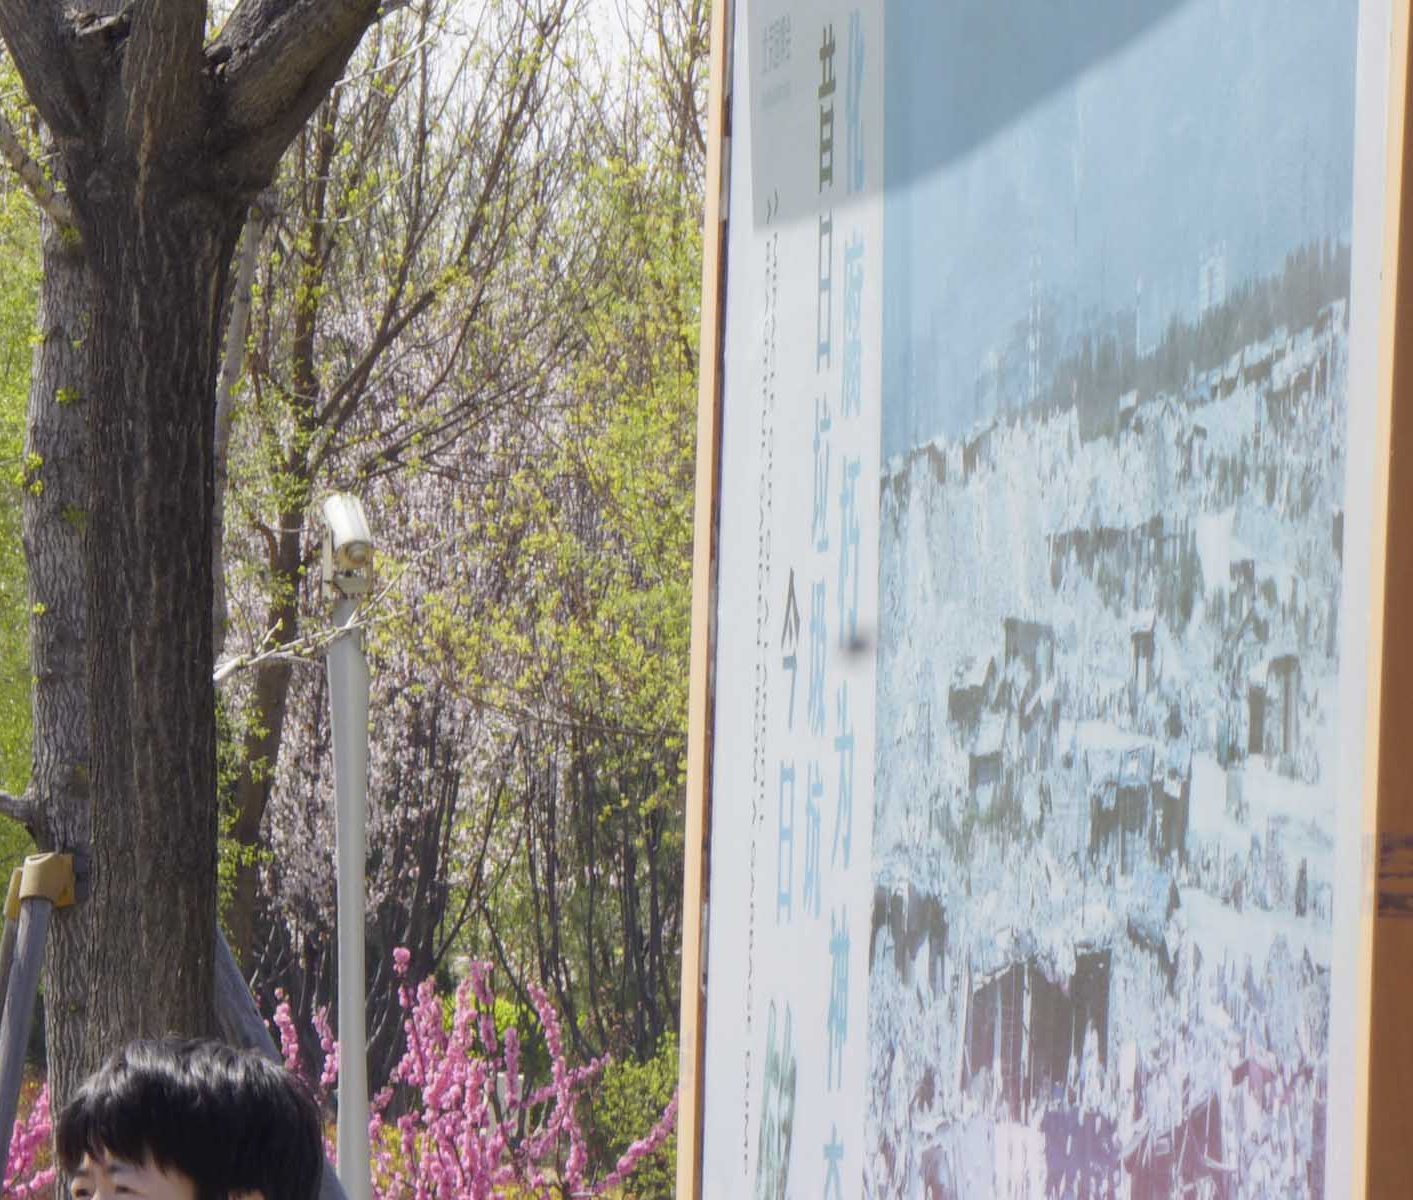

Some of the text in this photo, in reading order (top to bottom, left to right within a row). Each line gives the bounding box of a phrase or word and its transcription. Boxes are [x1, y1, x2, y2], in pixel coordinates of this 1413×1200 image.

[777, 567, 801, 925] 今日
[802, 22, 836, 919] 昔日垃圾坑
